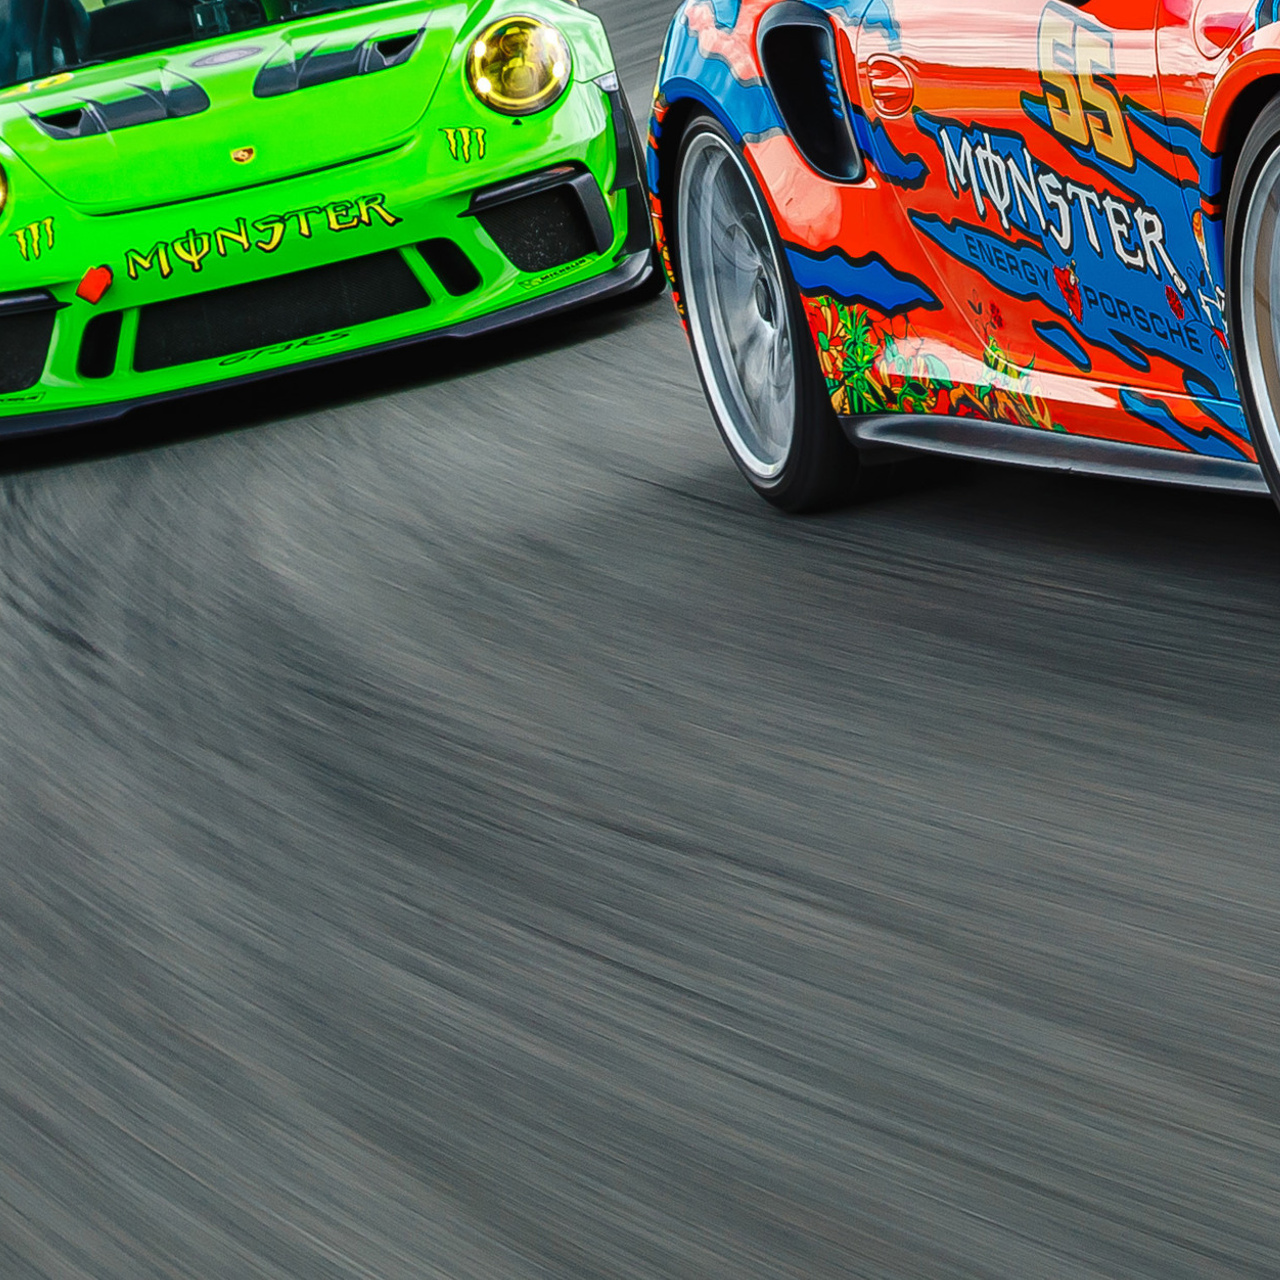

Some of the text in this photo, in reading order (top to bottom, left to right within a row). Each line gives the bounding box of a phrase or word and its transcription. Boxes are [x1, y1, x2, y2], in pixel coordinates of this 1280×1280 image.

[1037, 1, 1135, 169] 55
[125, 193, 403, 279] MONSTER
[940, 128, 1188, 294] MONSTER
[964, 234, 1050, 292] ENERGY
[1082, 284, 1203, 357] PORSCHE
